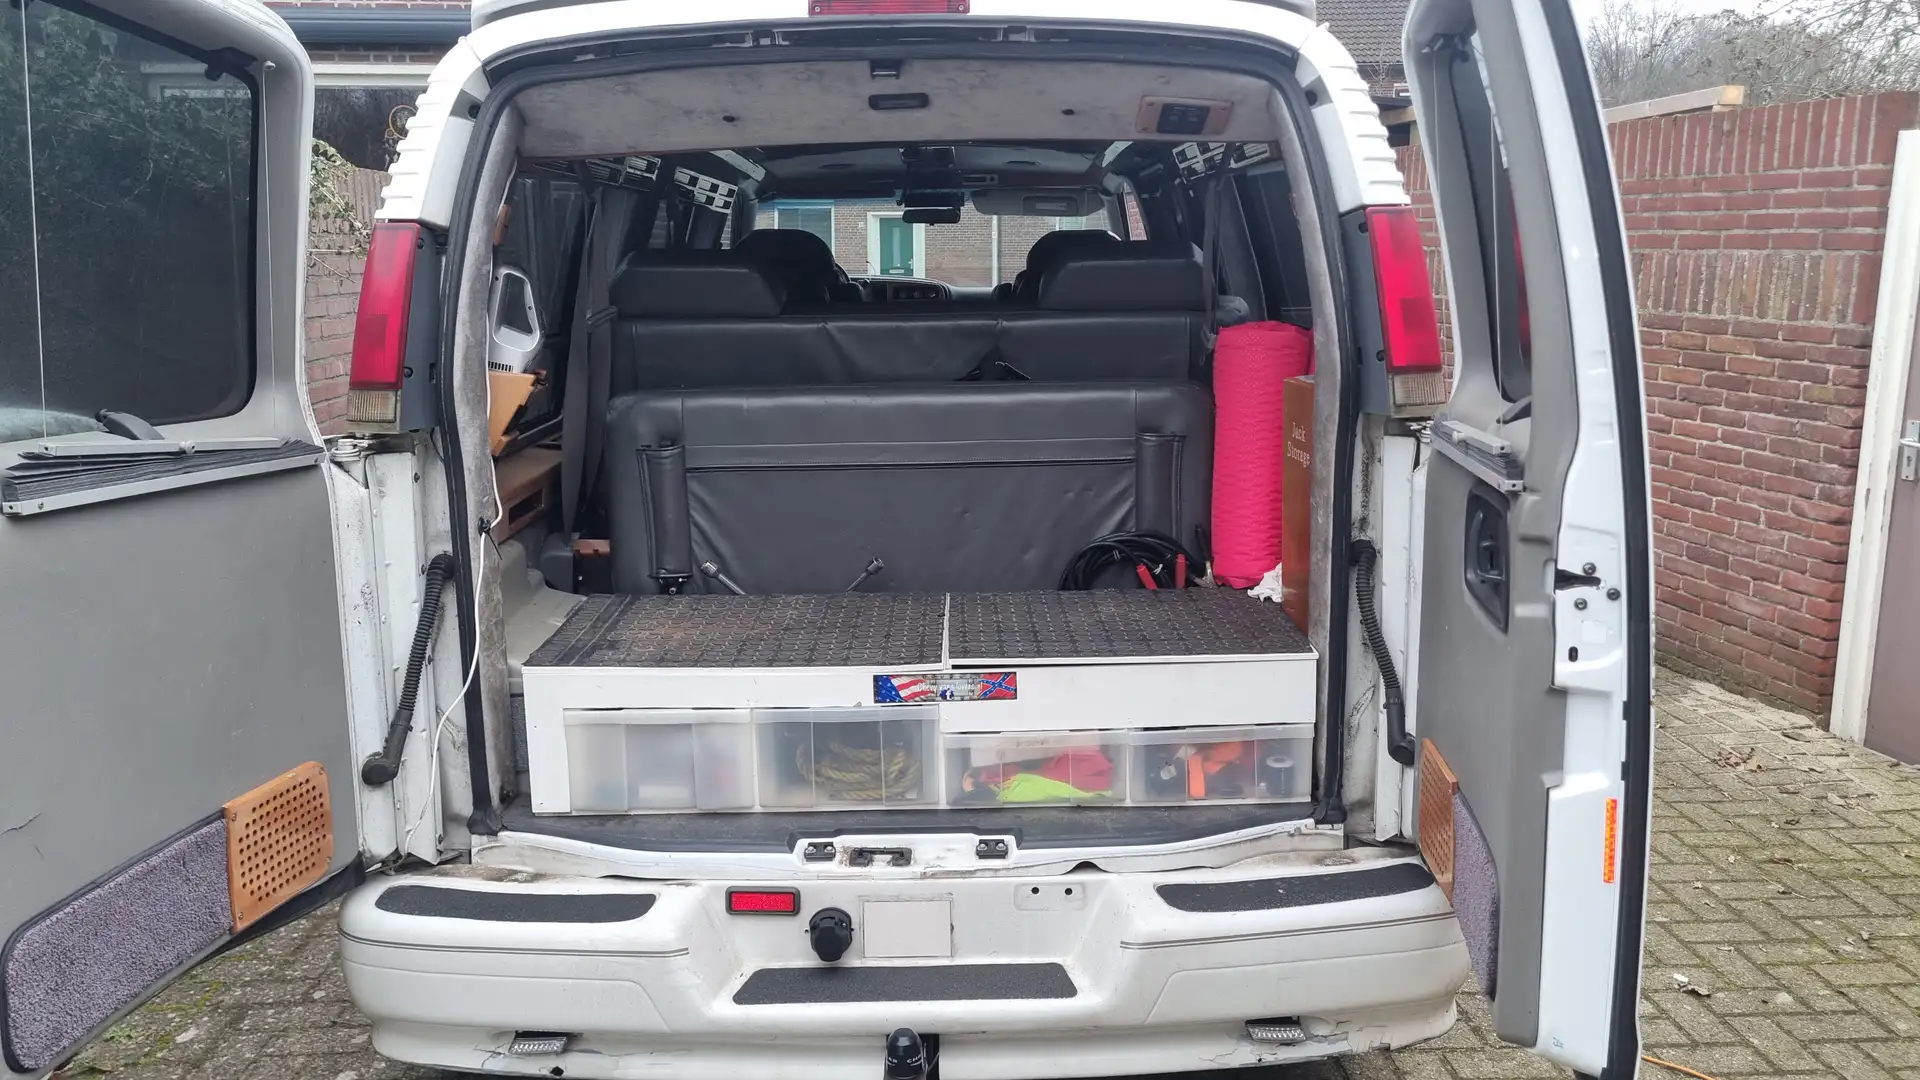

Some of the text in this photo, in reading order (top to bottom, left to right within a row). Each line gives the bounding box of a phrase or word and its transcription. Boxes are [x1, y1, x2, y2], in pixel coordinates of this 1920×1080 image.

[1292, 421, 1306, 442] Jack
[1287, 441, 1311, 468] Storage
[917, 682, 937, 693] Chevy
